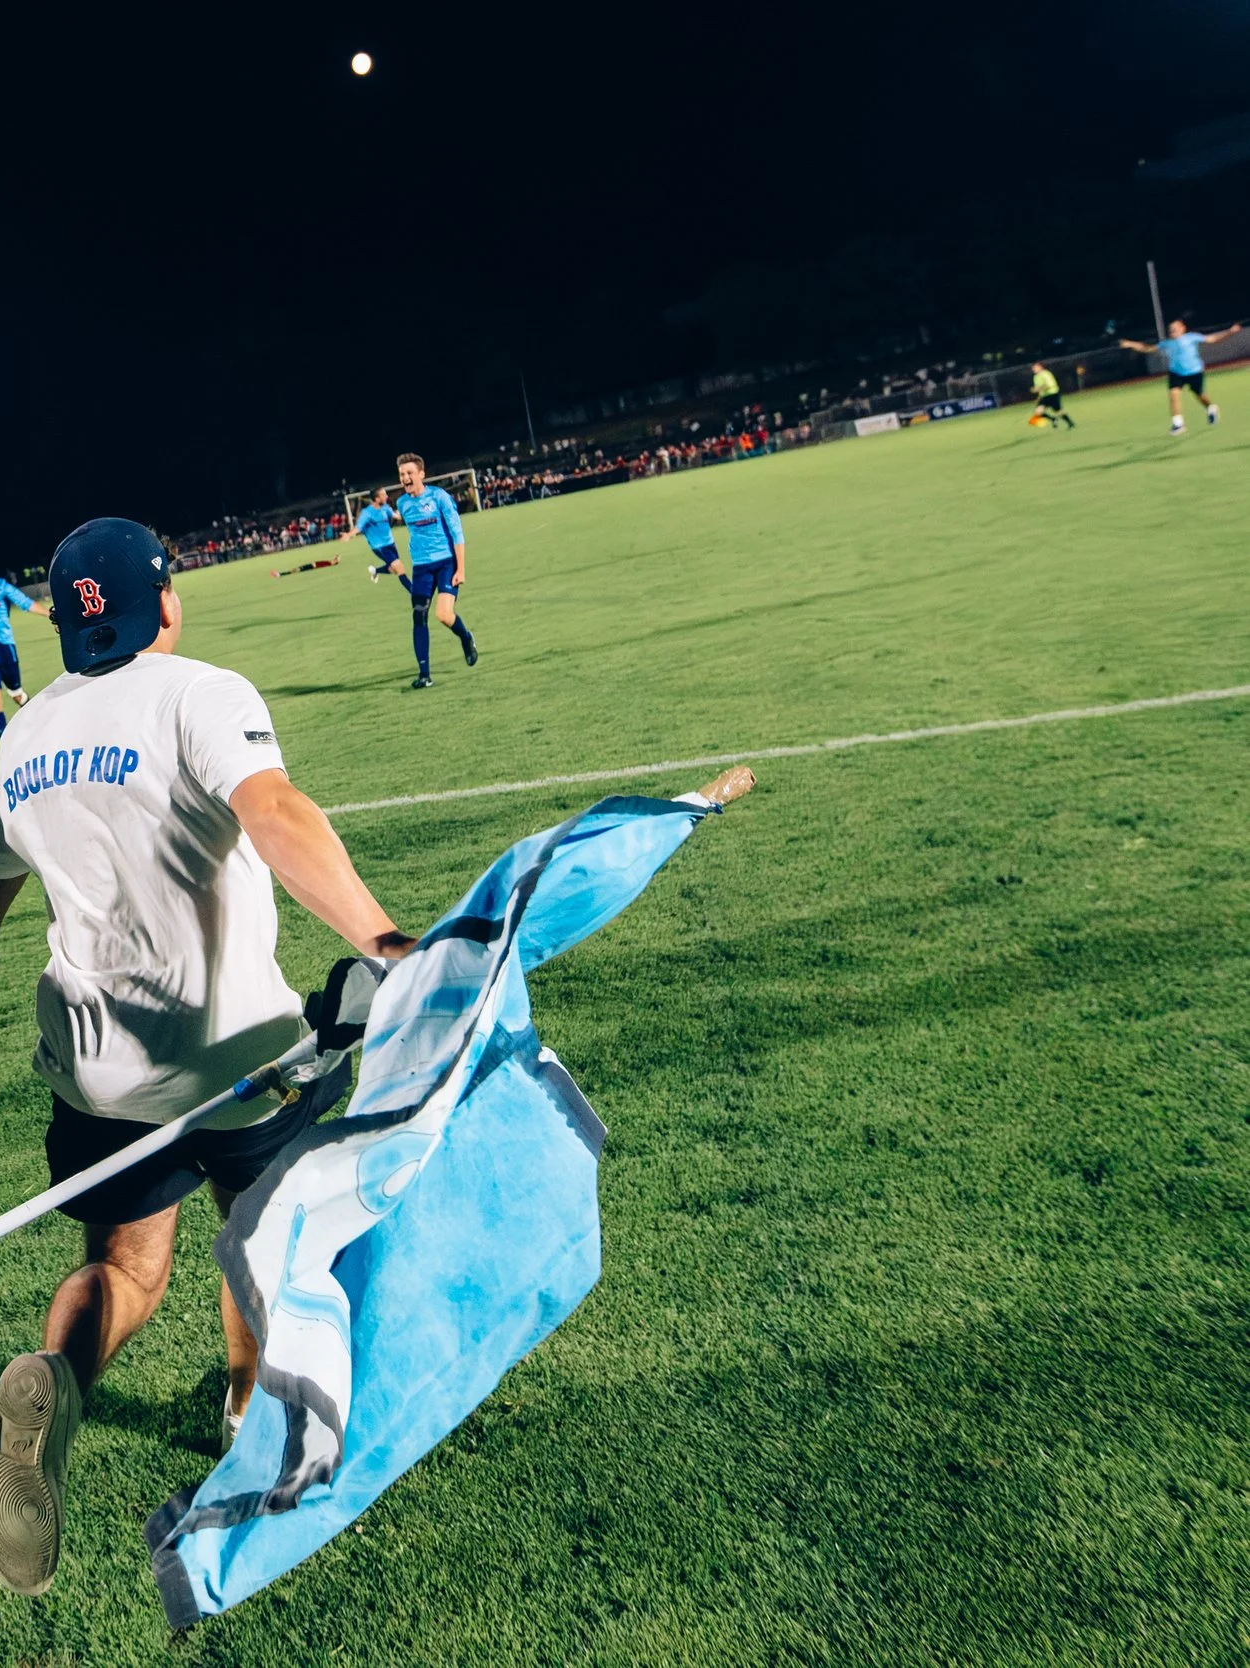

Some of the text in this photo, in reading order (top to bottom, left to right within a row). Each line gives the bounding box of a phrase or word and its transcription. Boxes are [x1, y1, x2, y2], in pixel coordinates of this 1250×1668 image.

[73, 577, 107, 618] B
[3, 746, 139, 813] BOULOT KOP
